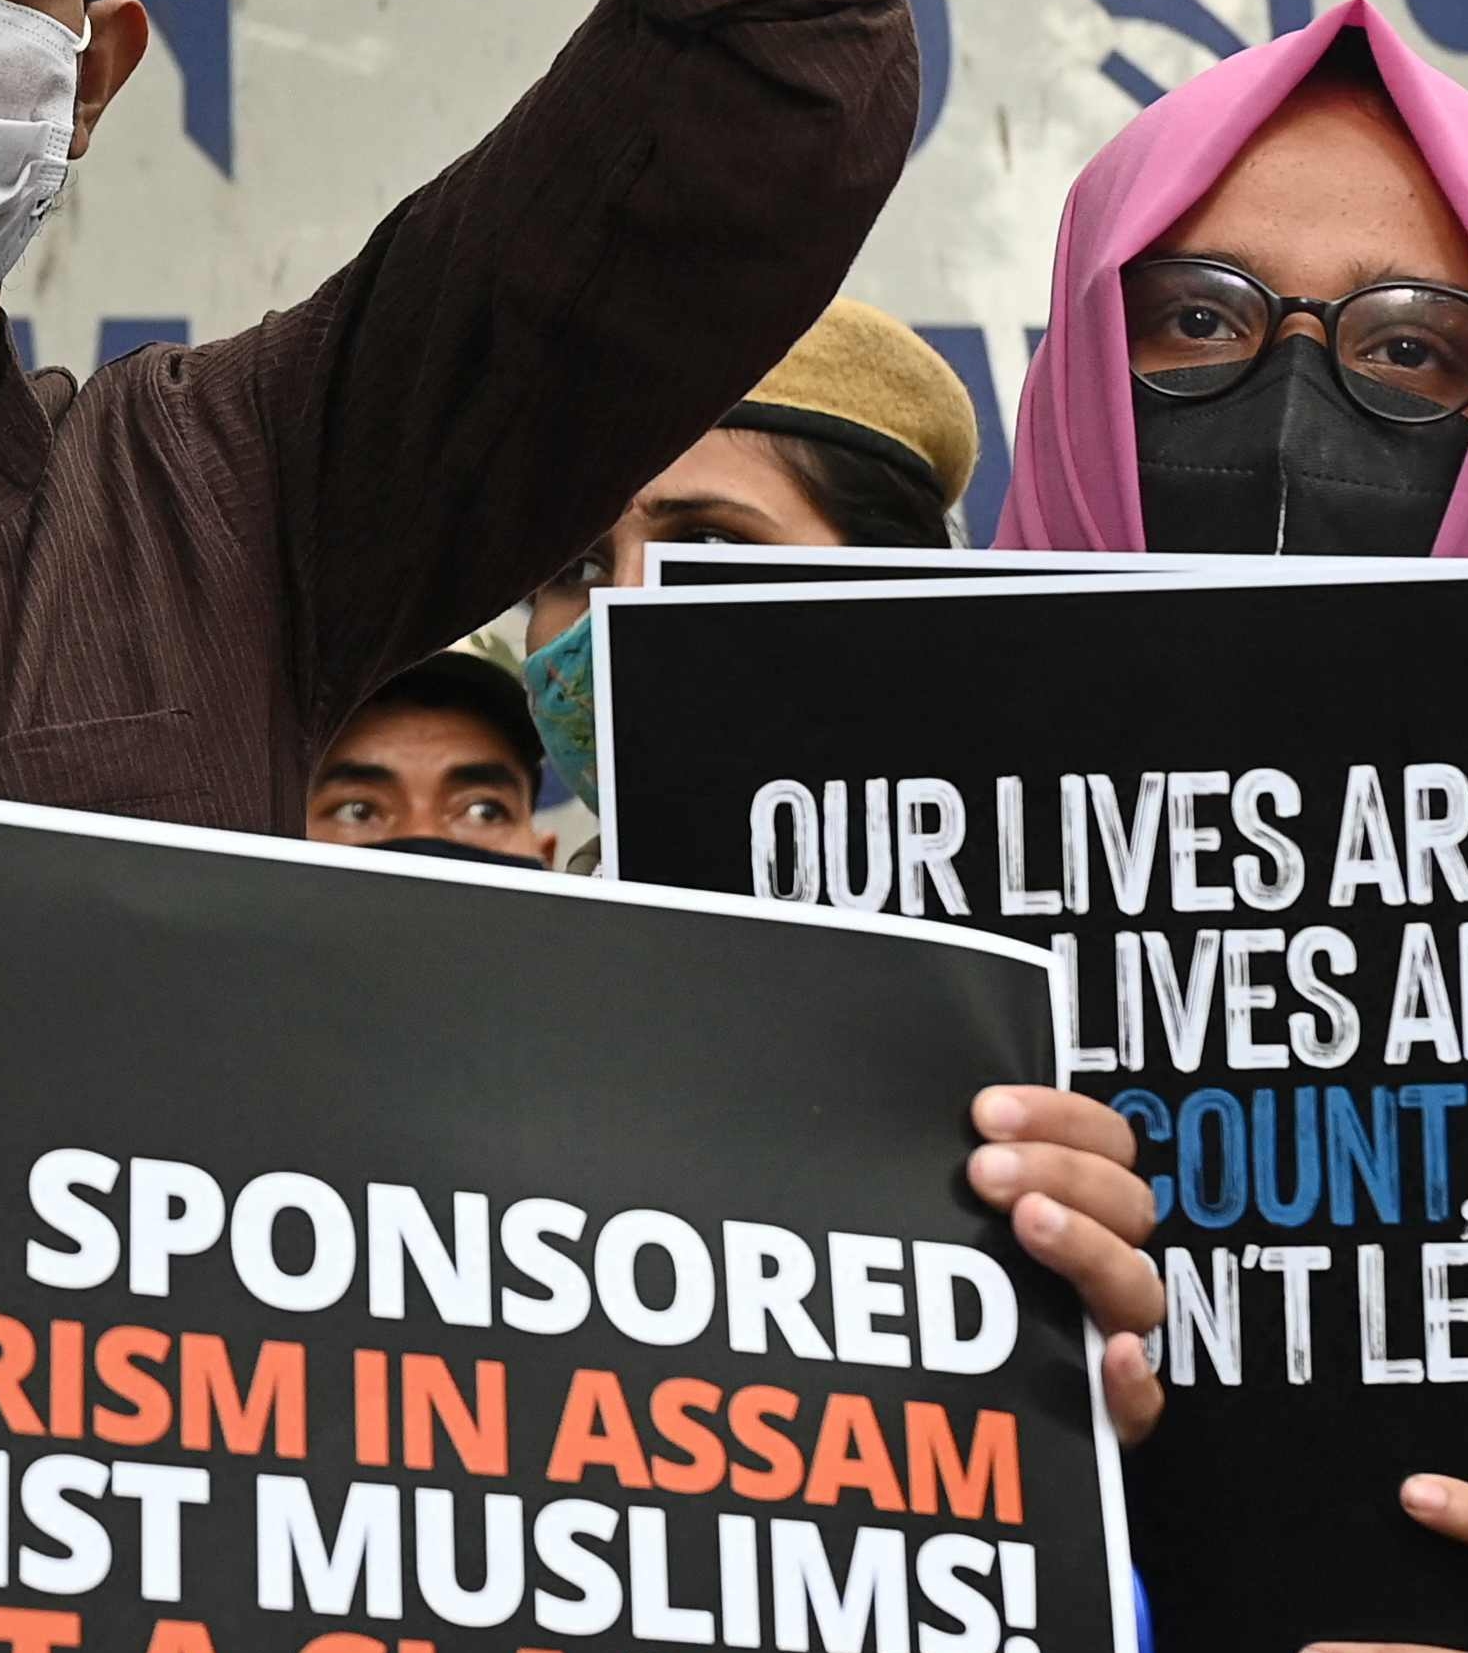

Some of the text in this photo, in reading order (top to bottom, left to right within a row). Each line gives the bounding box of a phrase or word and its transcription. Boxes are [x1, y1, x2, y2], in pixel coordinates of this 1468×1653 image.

[749, 777, 973, 917] OUR
[996, 767, 1305, 916] LIVES
[1051, 925, 1360, 1074] LIVES
[26, 1147, 1020, 1375] SPONSORED
[354, 1348, 509, 1478] IN
[546, 1367, 1024, 1526] ASSAM
[255, 1472, 1038, 1653] MUSLIMS!
